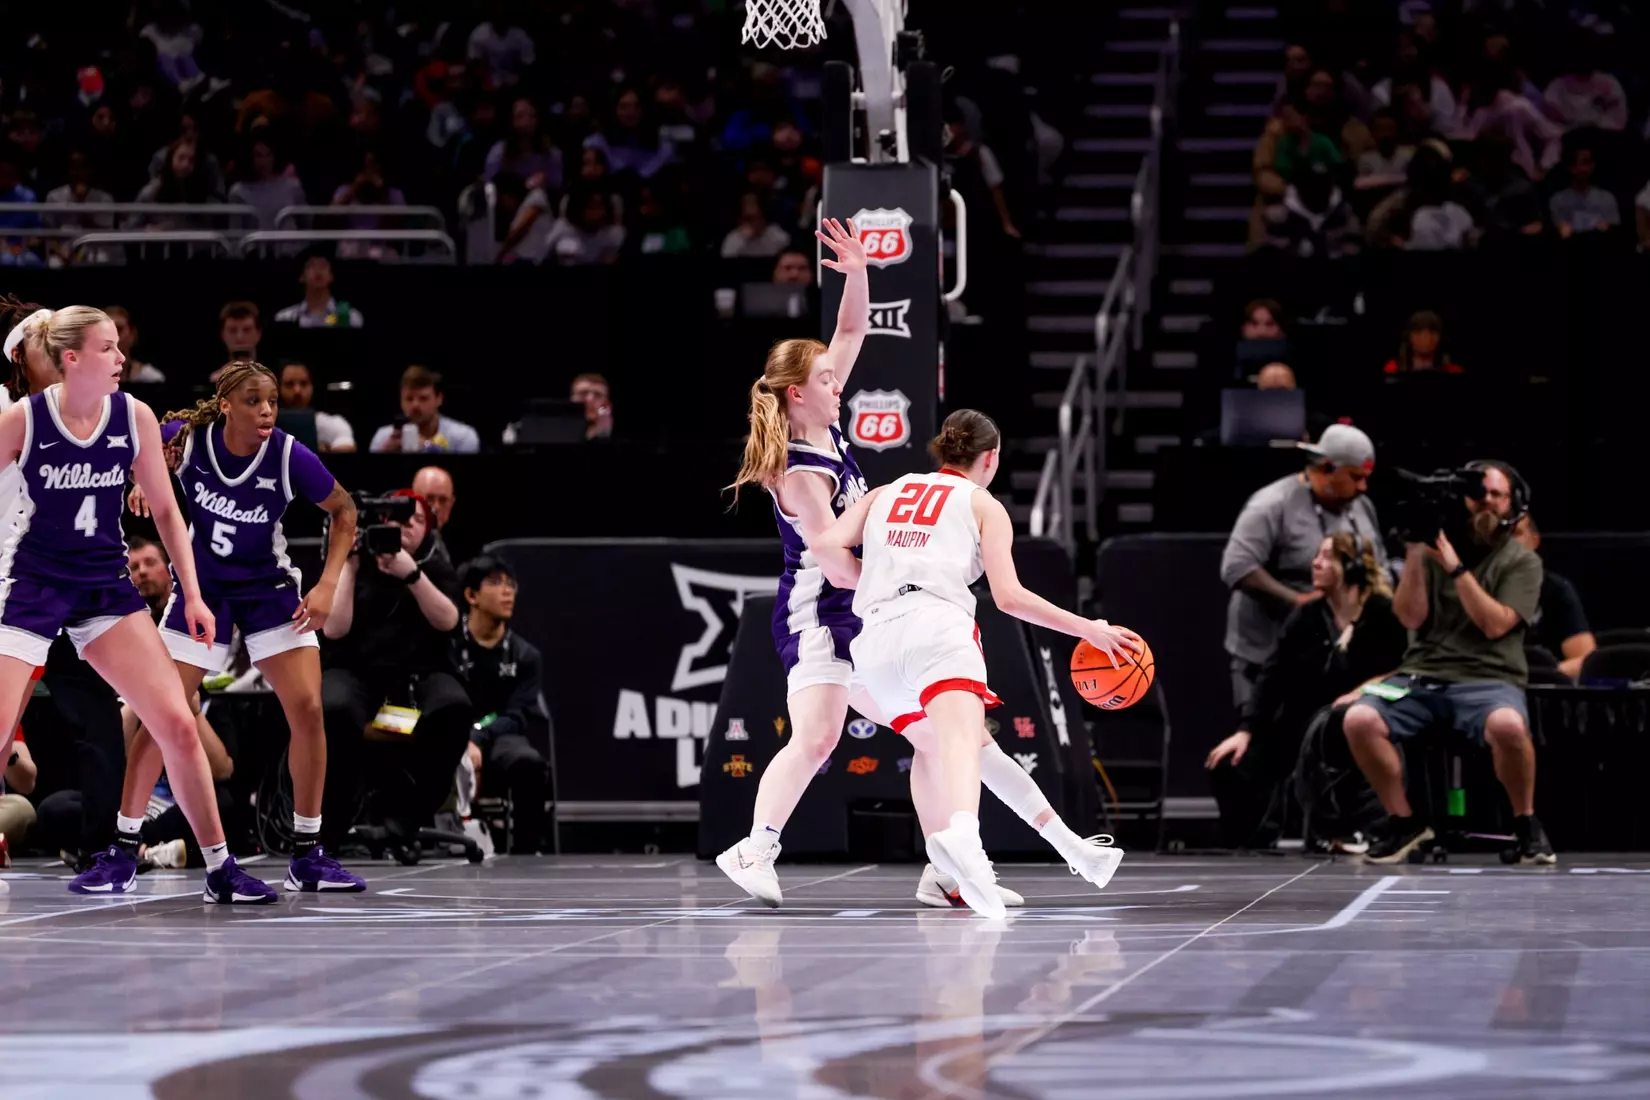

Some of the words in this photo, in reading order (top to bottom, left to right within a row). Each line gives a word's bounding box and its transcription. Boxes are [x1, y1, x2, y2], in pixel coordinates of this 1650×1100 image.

[863, 230, 901, 255] 66
[858, 399, 900, 410] PHILLIPS
[861, 414, 899, 438] 66
[39, 462, 125, 489] Wildcats
[74, 494, 98, 537] 4
[194, 481, 269, 524] Wildcats
[886, 482, 955, 527] 20
[210, 520, 237, 557] 5
[885, 529, 931, 548] MAUPIN
[613, 688, 651, 739] A
